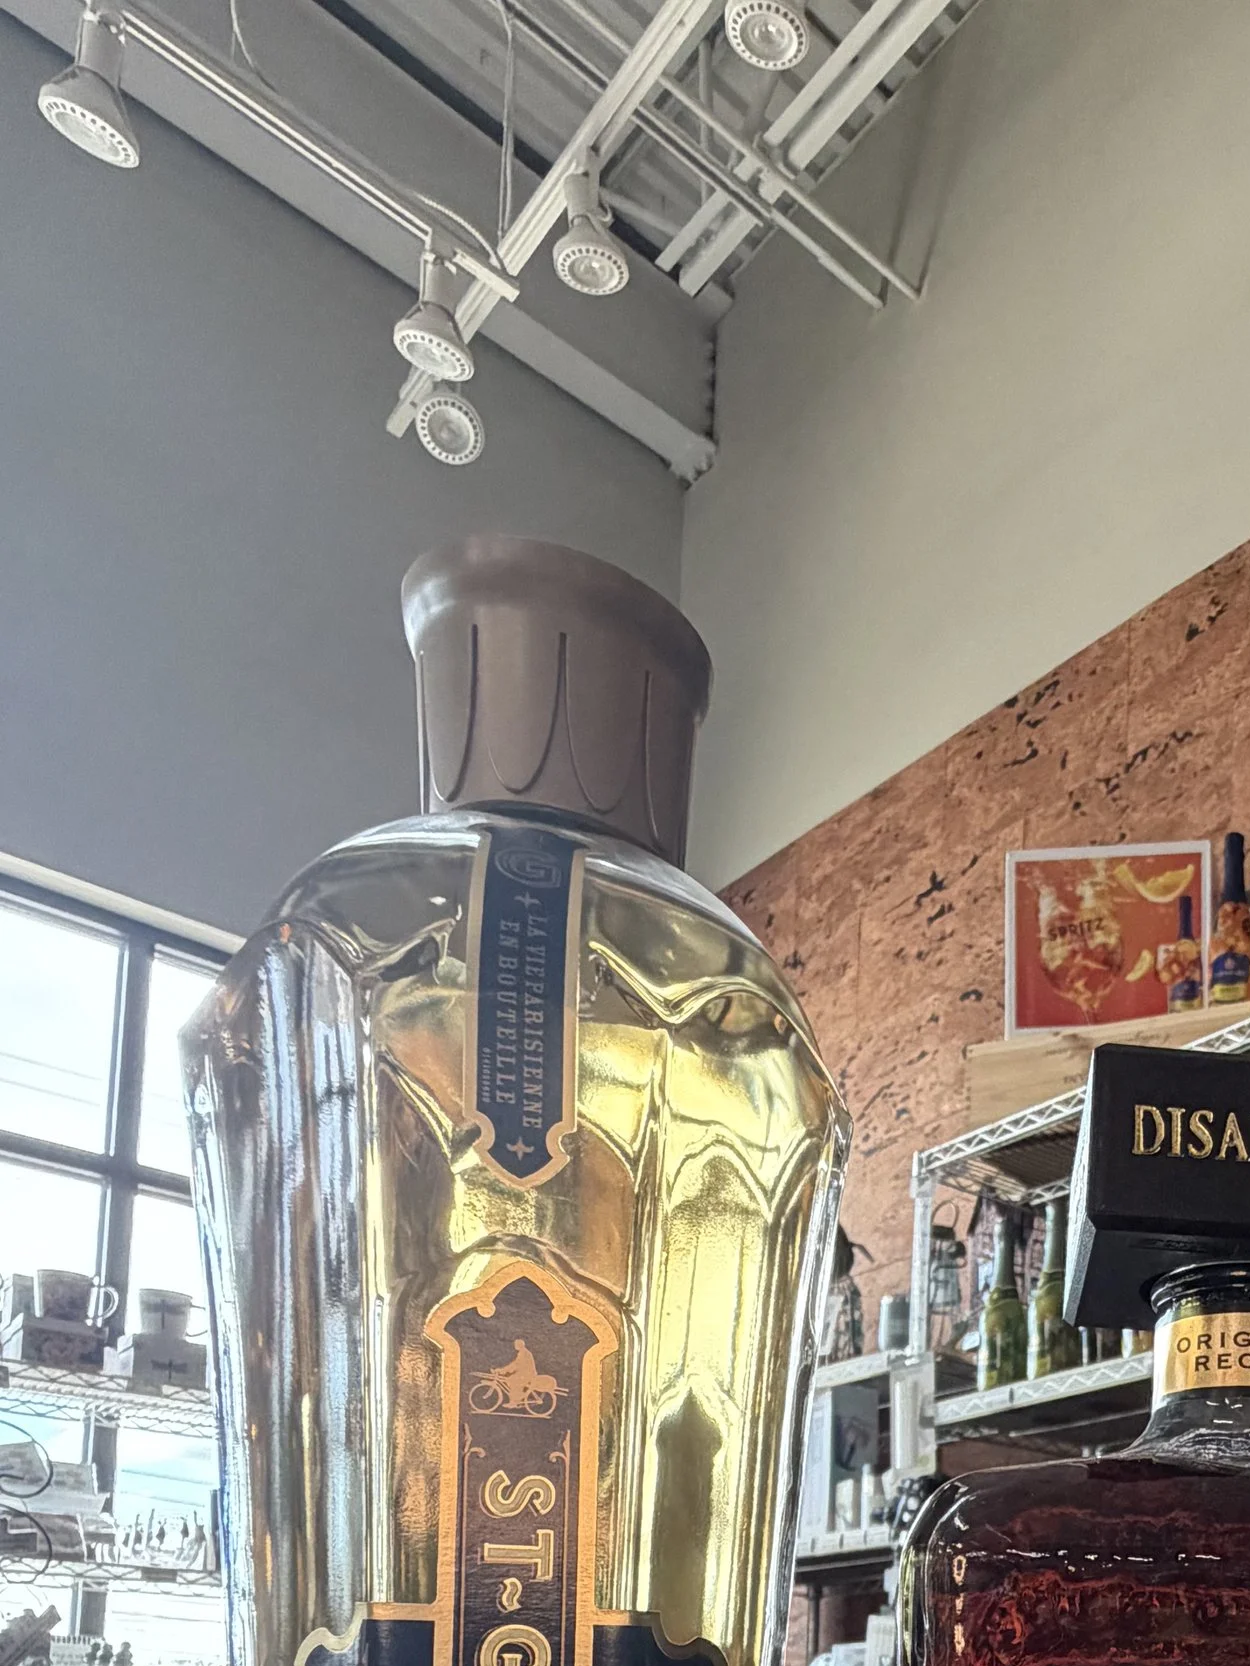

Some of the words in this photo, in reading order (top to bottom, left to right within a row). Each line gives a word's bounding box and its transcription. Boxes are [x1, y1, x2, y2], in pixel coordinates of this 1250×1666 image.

[499, 918, 520, 949] EN
[524, 913, 549, 938] LA
[524, 943, 547, 977] VIE
[495, 955, 519, 1105] BOUTEILLE
[522, 980, 546, 1130] PARISIENNE
